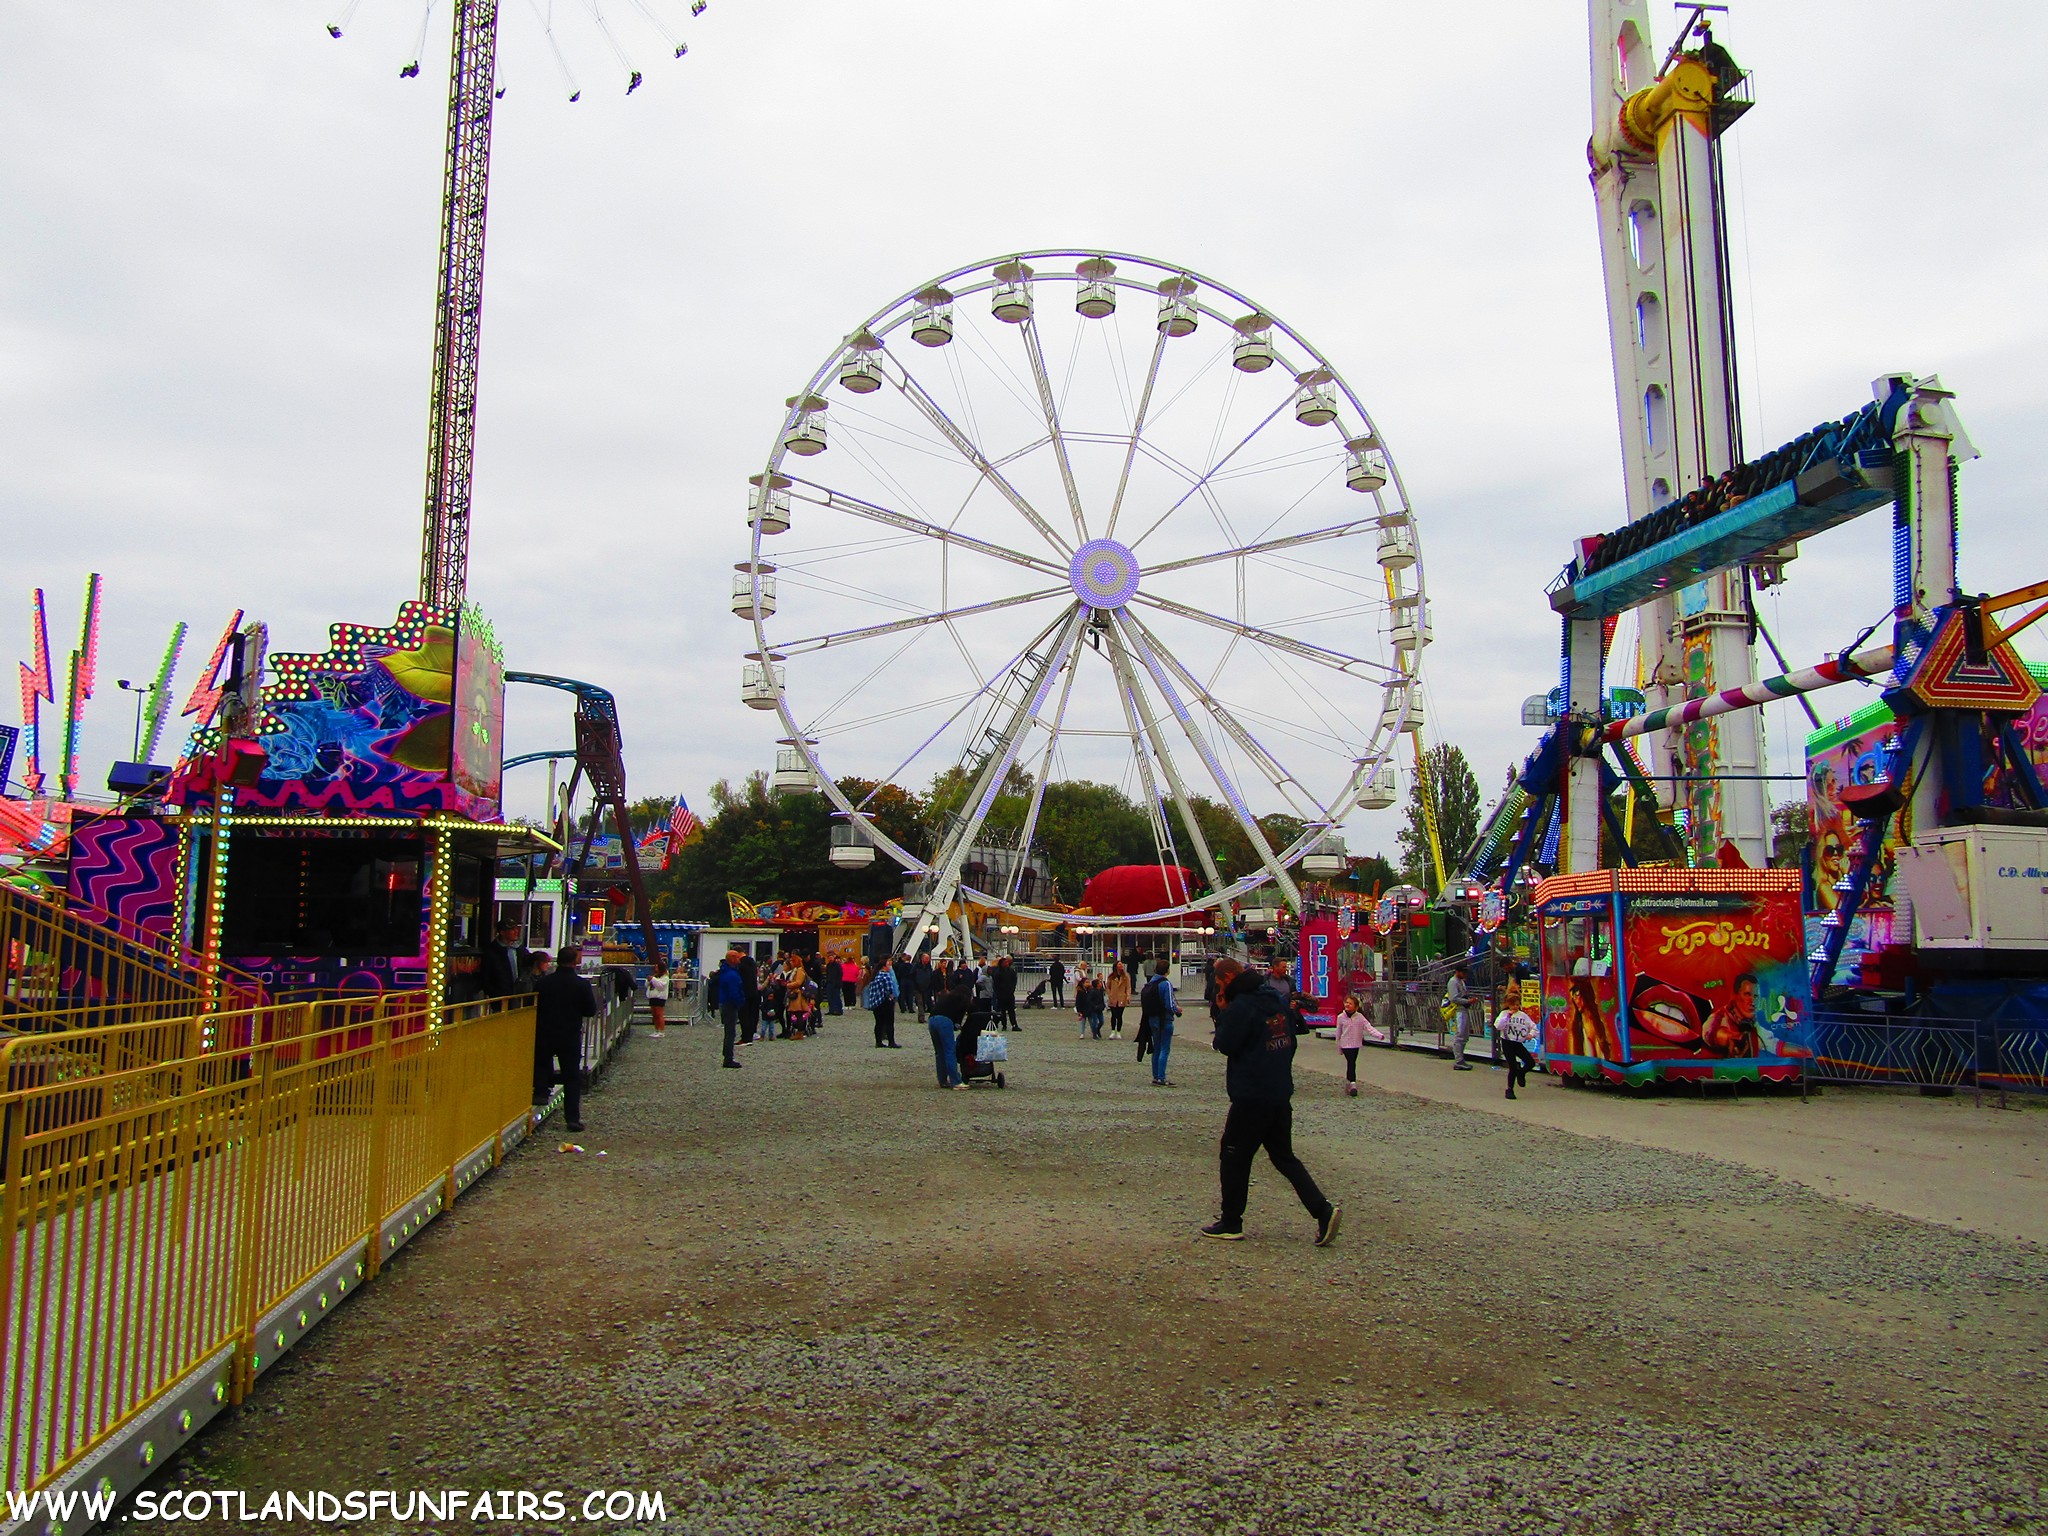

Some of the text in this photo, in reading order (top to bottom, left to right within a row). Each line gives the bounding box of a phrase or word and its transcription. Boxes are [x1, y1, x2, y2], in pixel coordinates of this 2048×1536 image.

[1658, 921, 1770, 955] Top Spin
[1309, 935, 1328, 998] FUN
[1507, 1025, 1527, 1041] NYC
